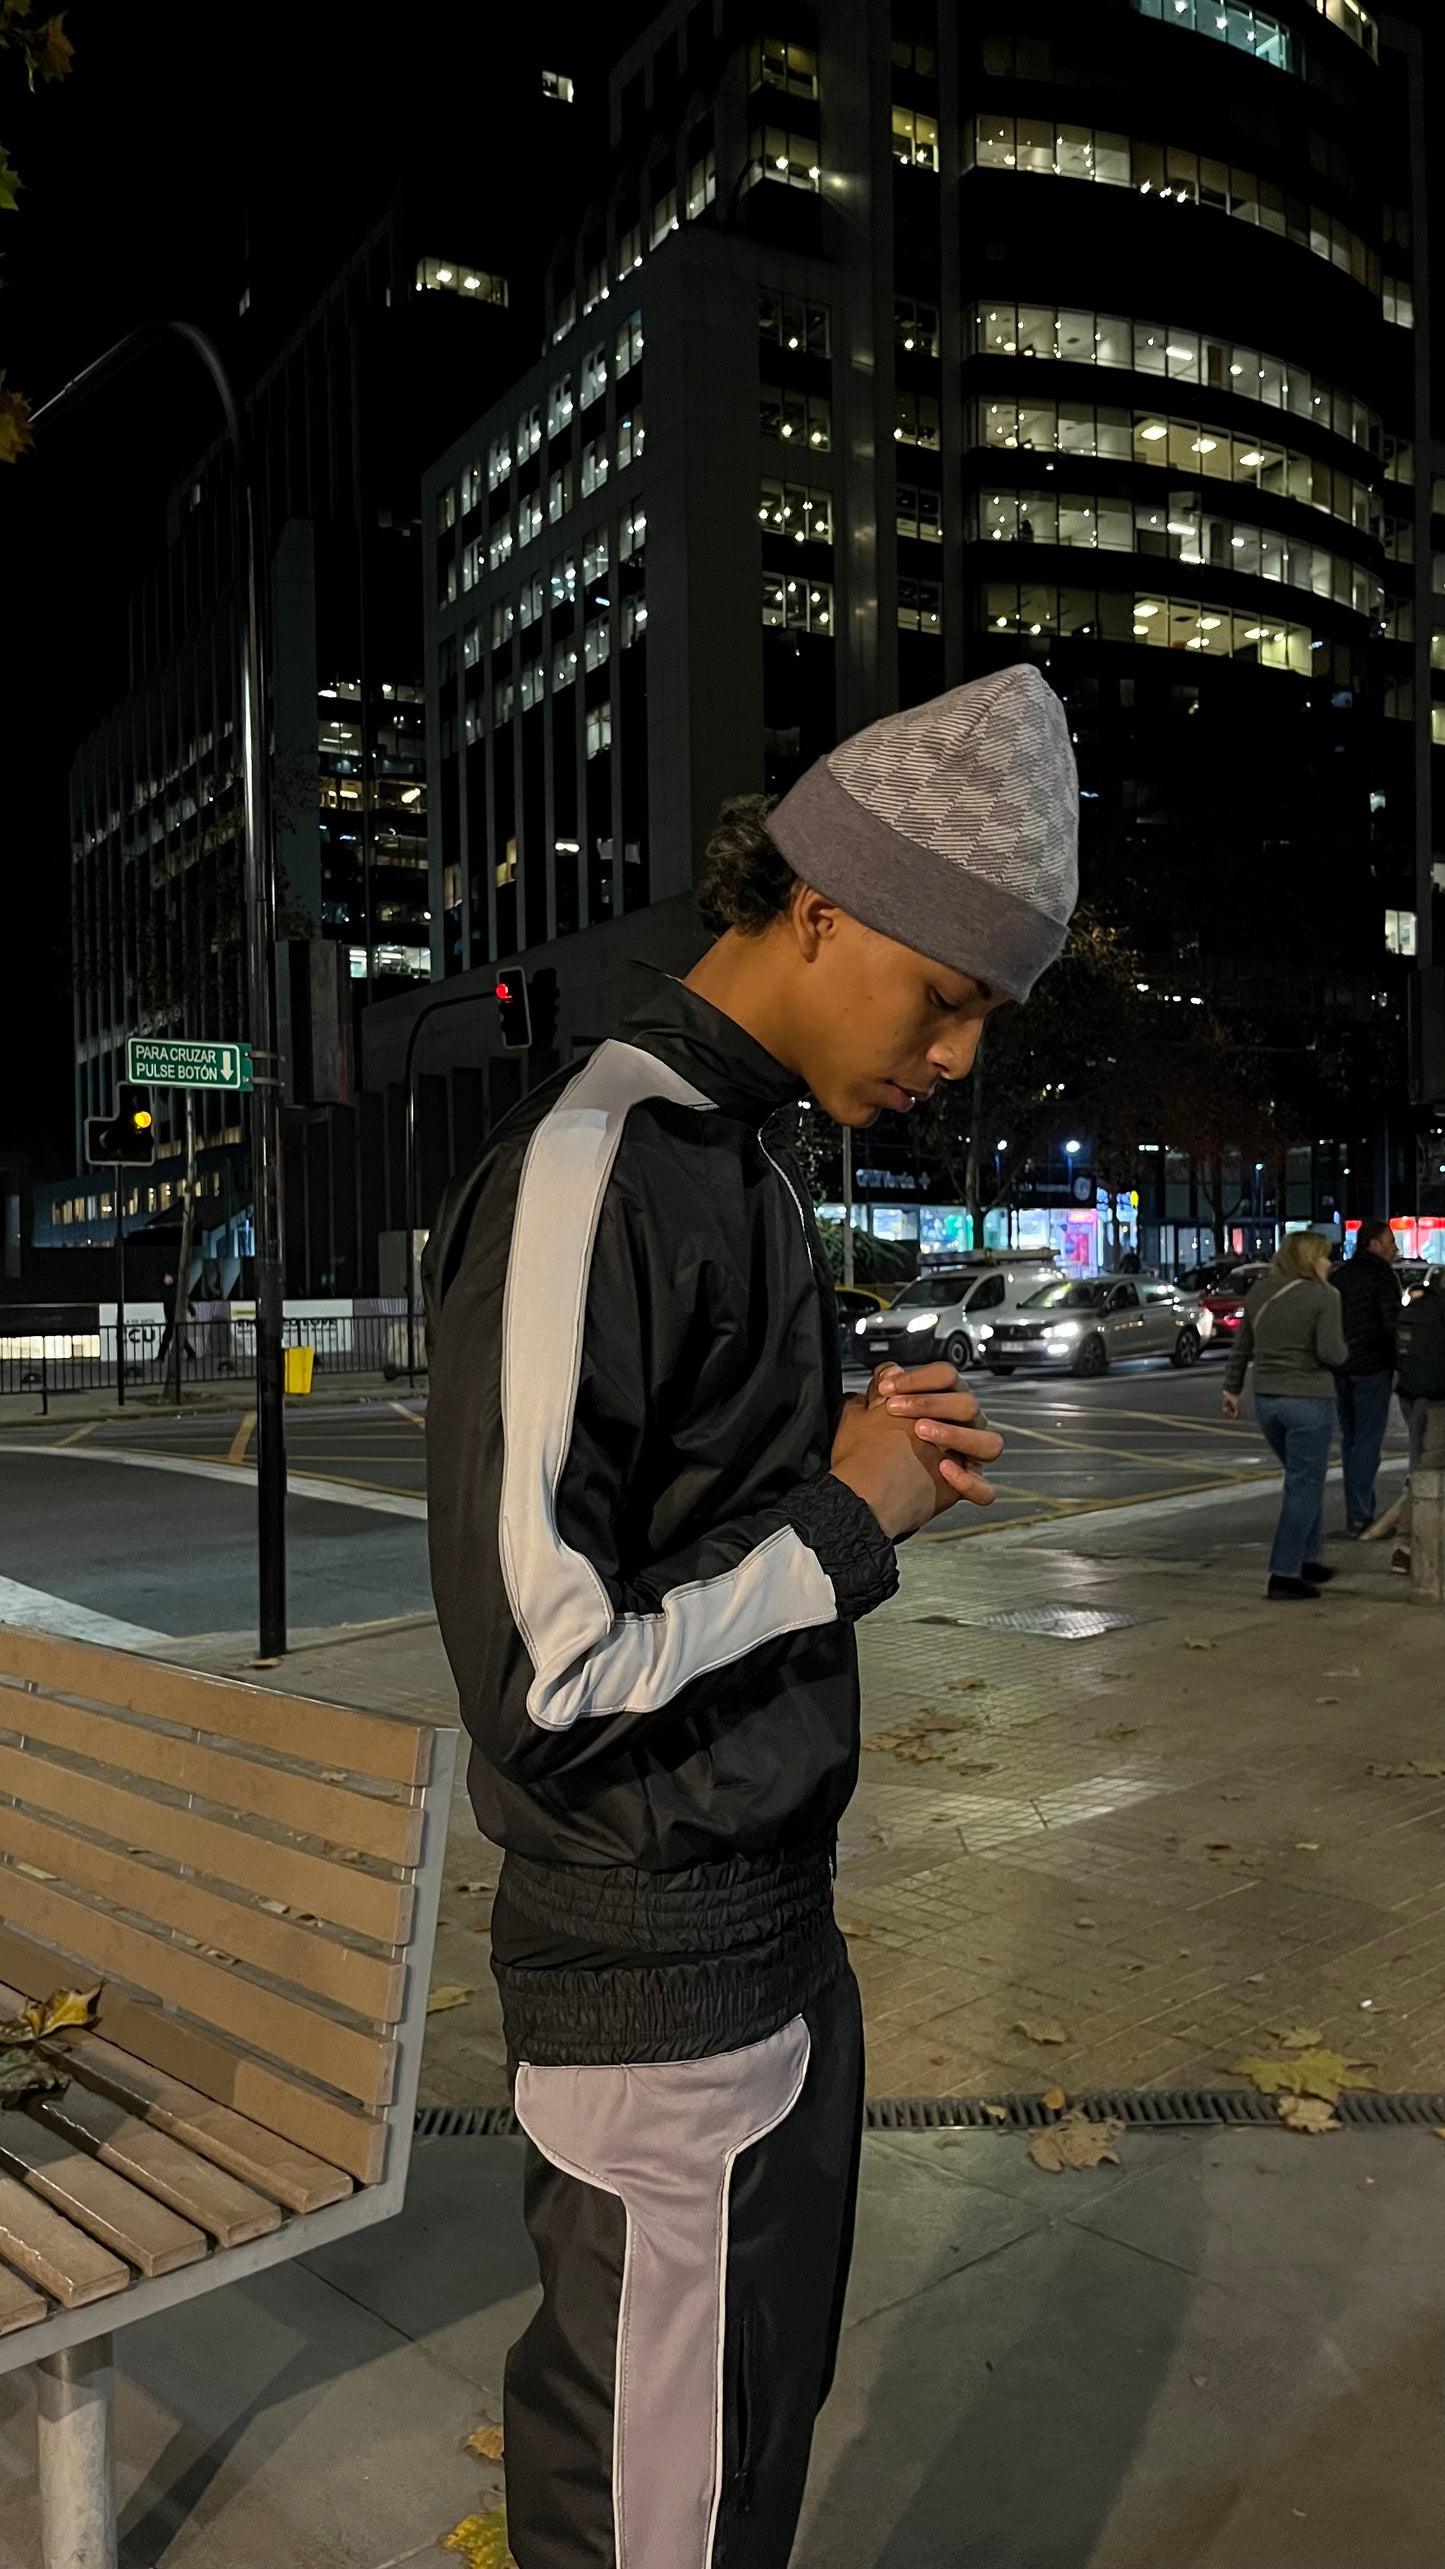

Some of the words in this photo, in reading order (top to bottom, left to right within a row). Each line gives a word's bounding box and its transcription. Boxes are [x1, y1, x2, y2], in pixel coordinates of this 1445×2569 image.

[136, 1045, 169, 1060] PARA
[170, 1048, 217, 1064] CRUZAR
[136, 1062, 176, 1079] PULSE
[178, 1064, 218, 1081] BOTÓN
